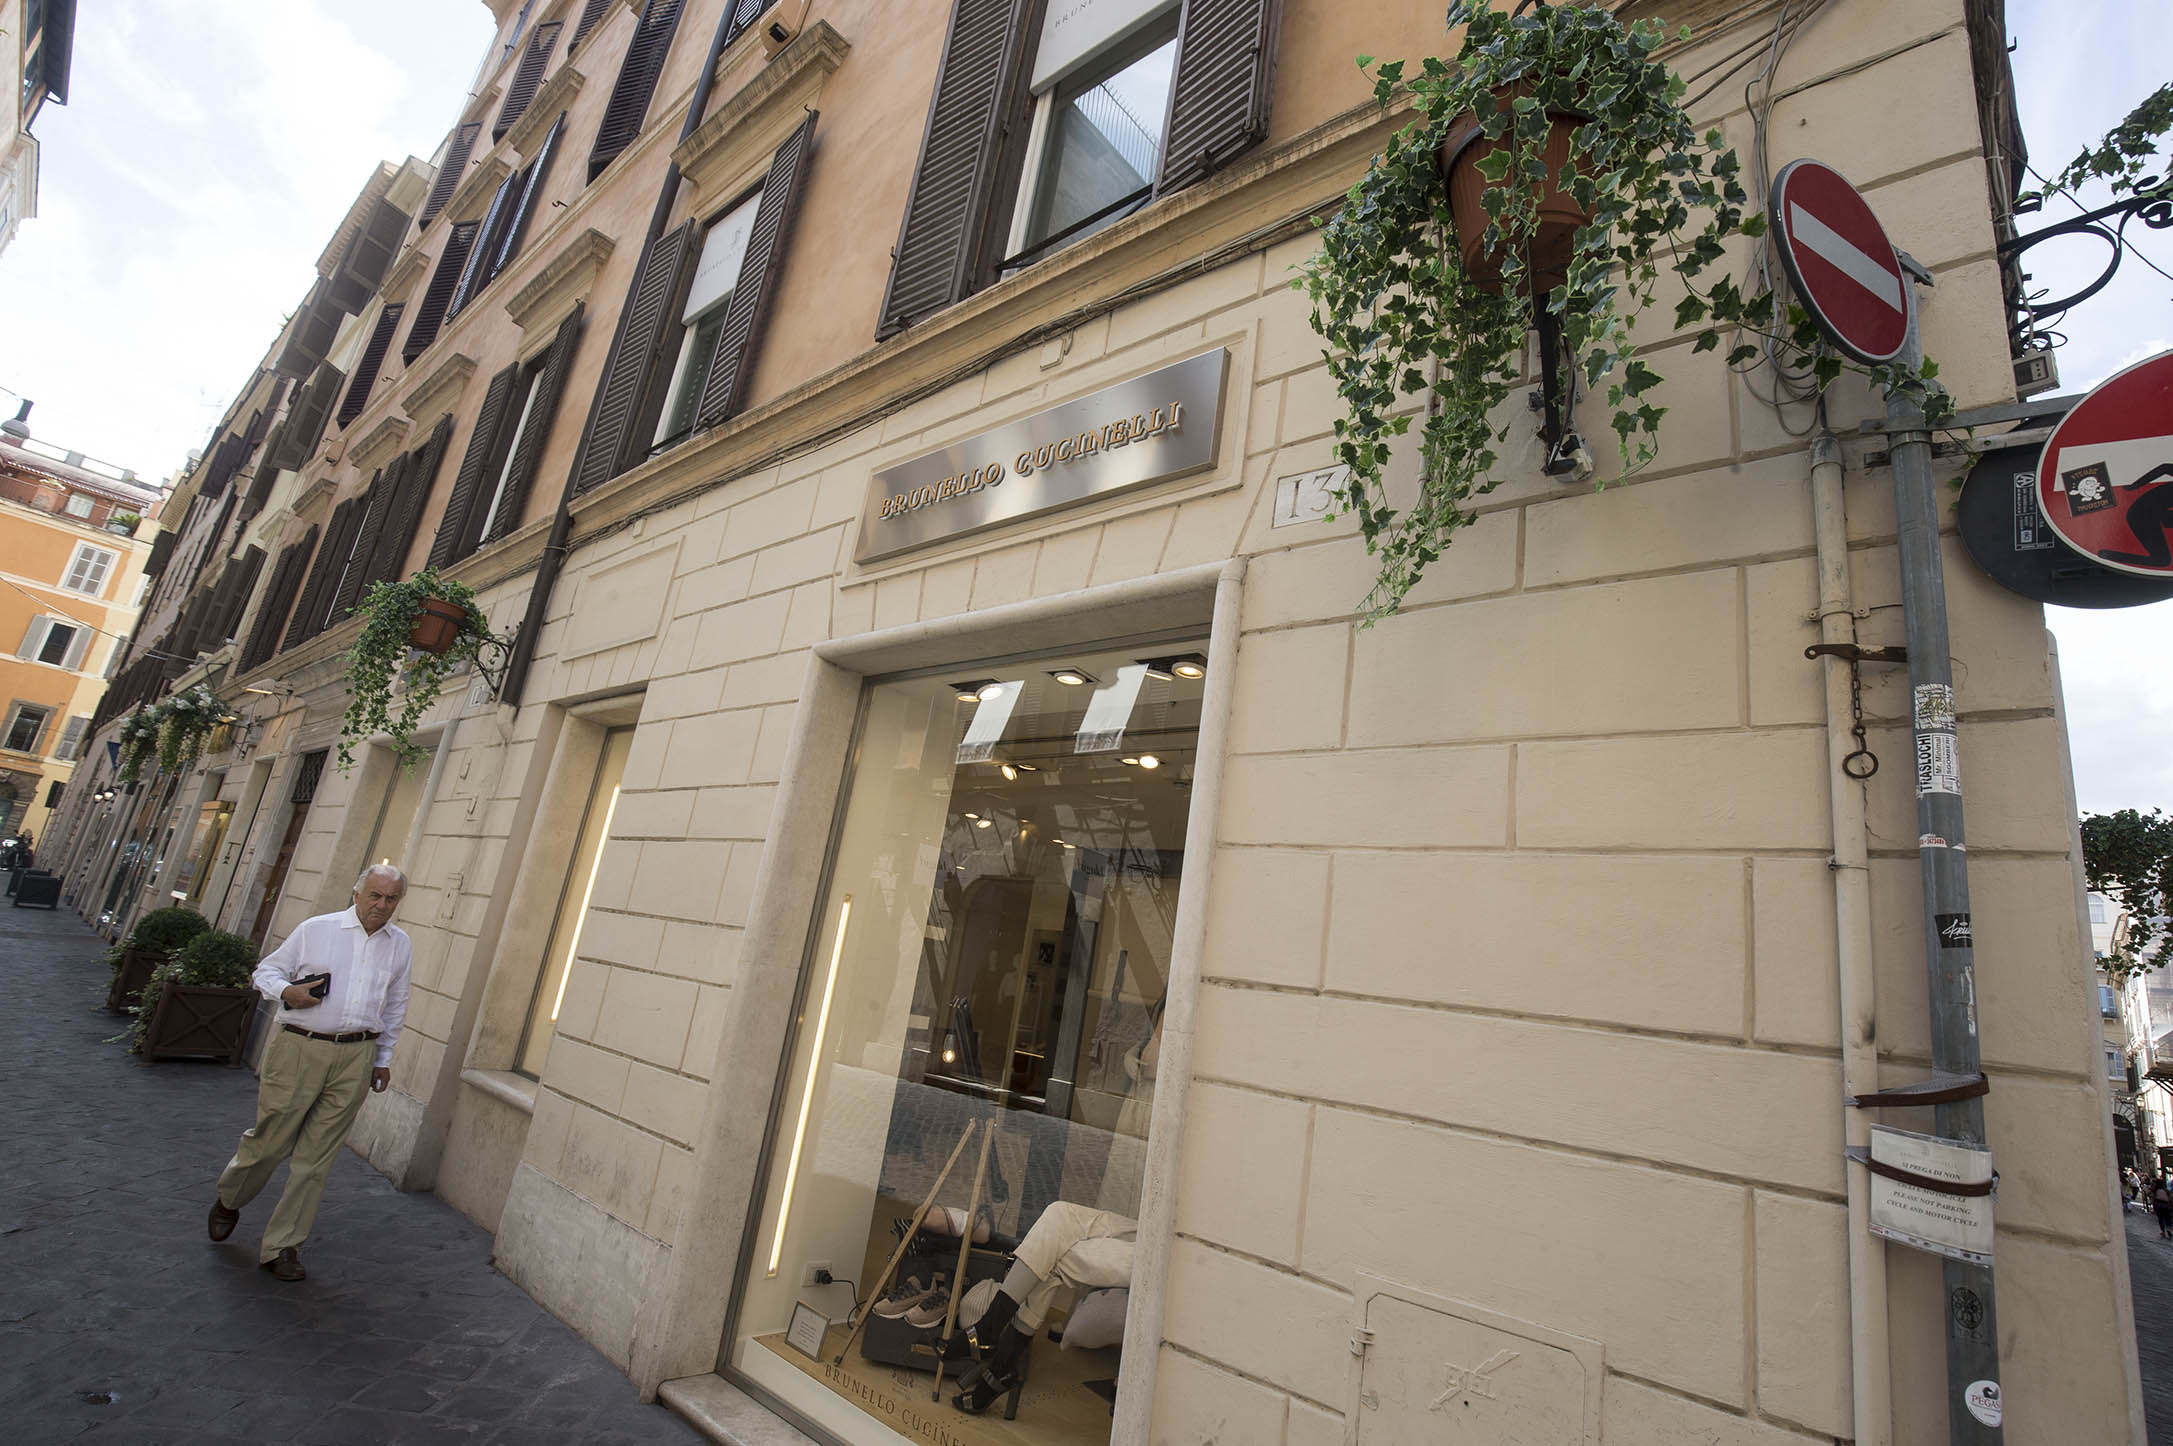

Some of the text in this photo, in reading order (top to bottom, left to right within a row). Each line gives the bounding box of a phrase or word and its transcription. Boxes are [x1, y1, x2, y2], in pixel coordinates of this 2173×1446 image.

[1055, 0, 1093, 28] BRUN
[878, 400, 1184, 519] BRUNELLO CUCINELLI
[1289, 471, 1333, 518] 13
[1886, 1199, 1978, 1227] CYCLE AND MOTOR CYCLE
[1919, 1197, 1935, 1207] NOT
[1936, 1202, 1972, 1215] PARKING
[824, 1363, 966, 1446] BRUNELLO CUCIN
